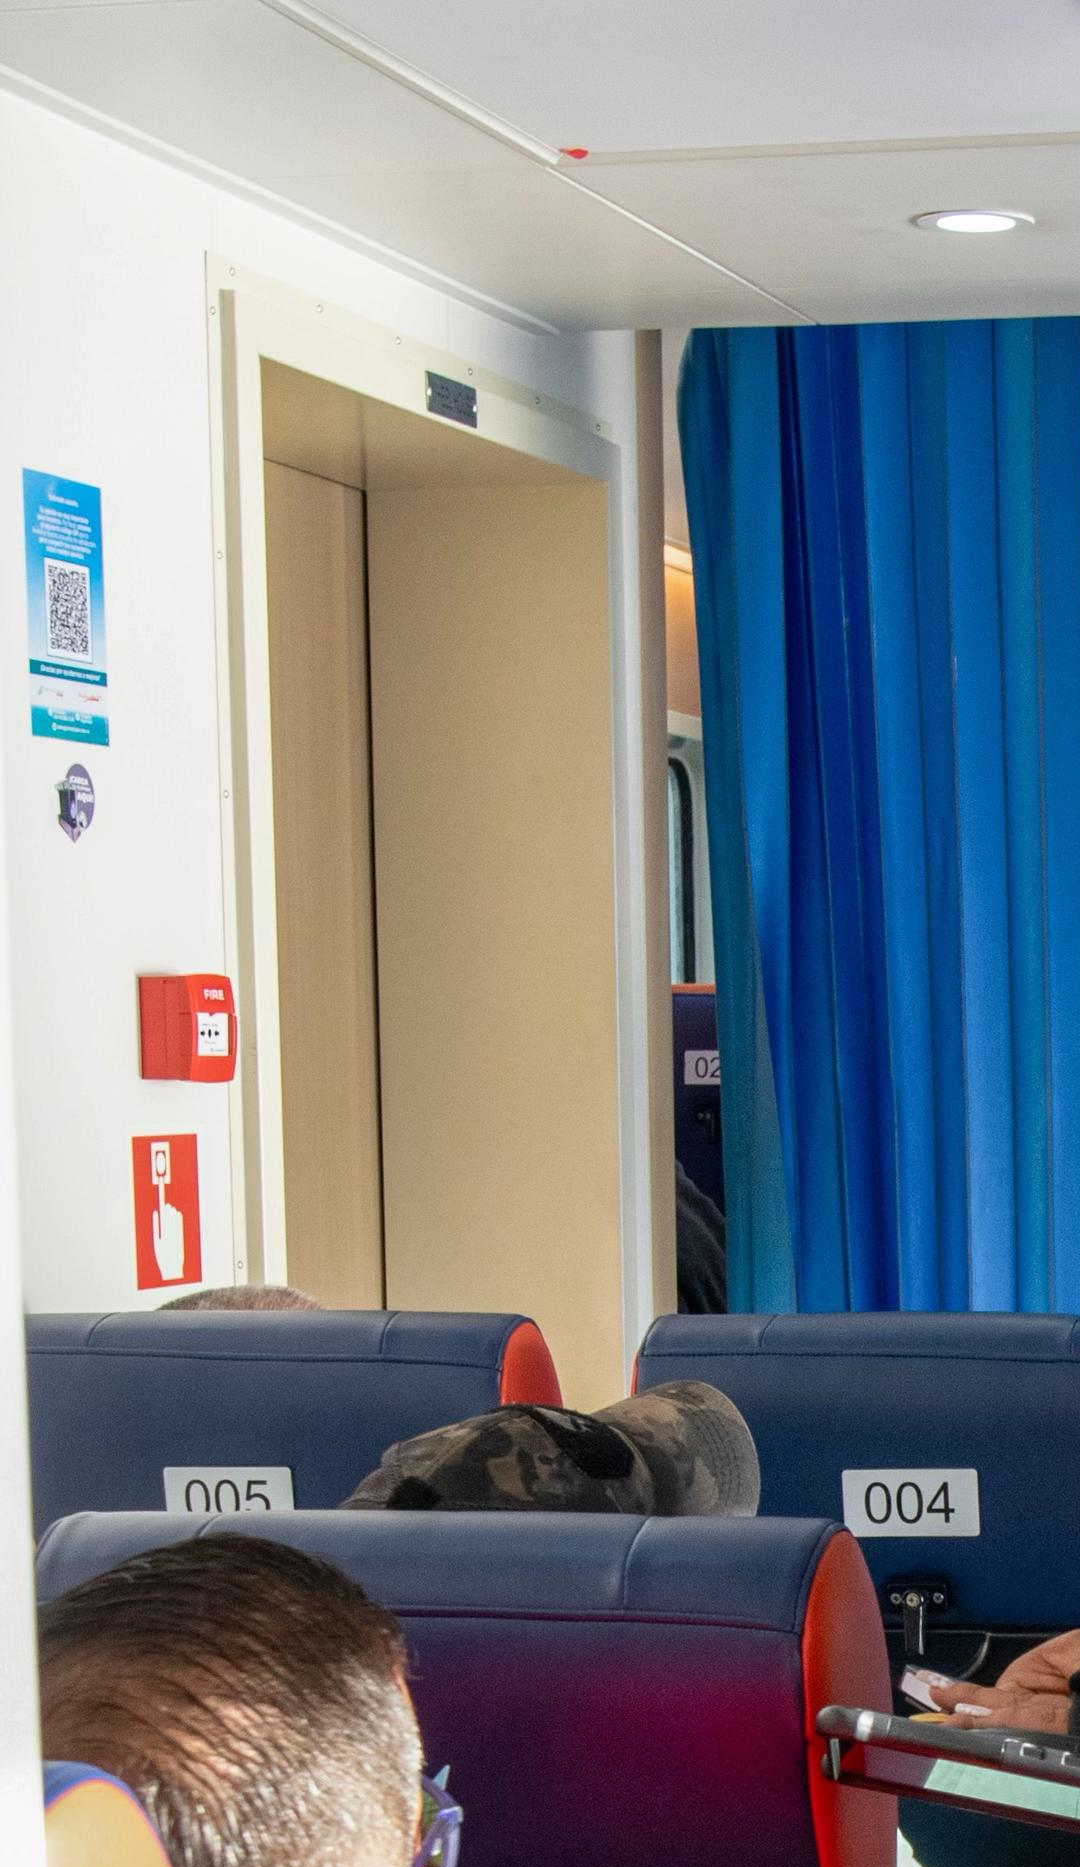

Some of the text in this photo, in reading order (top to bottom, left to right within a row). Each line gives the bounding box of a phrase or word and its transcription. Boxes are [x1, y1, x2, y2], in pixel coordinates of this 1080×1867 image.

[203, 989, 225, 1001] FIRE
[185, 1479, 271, 1513] 005
[864, 1481, 955, 1524] 004
